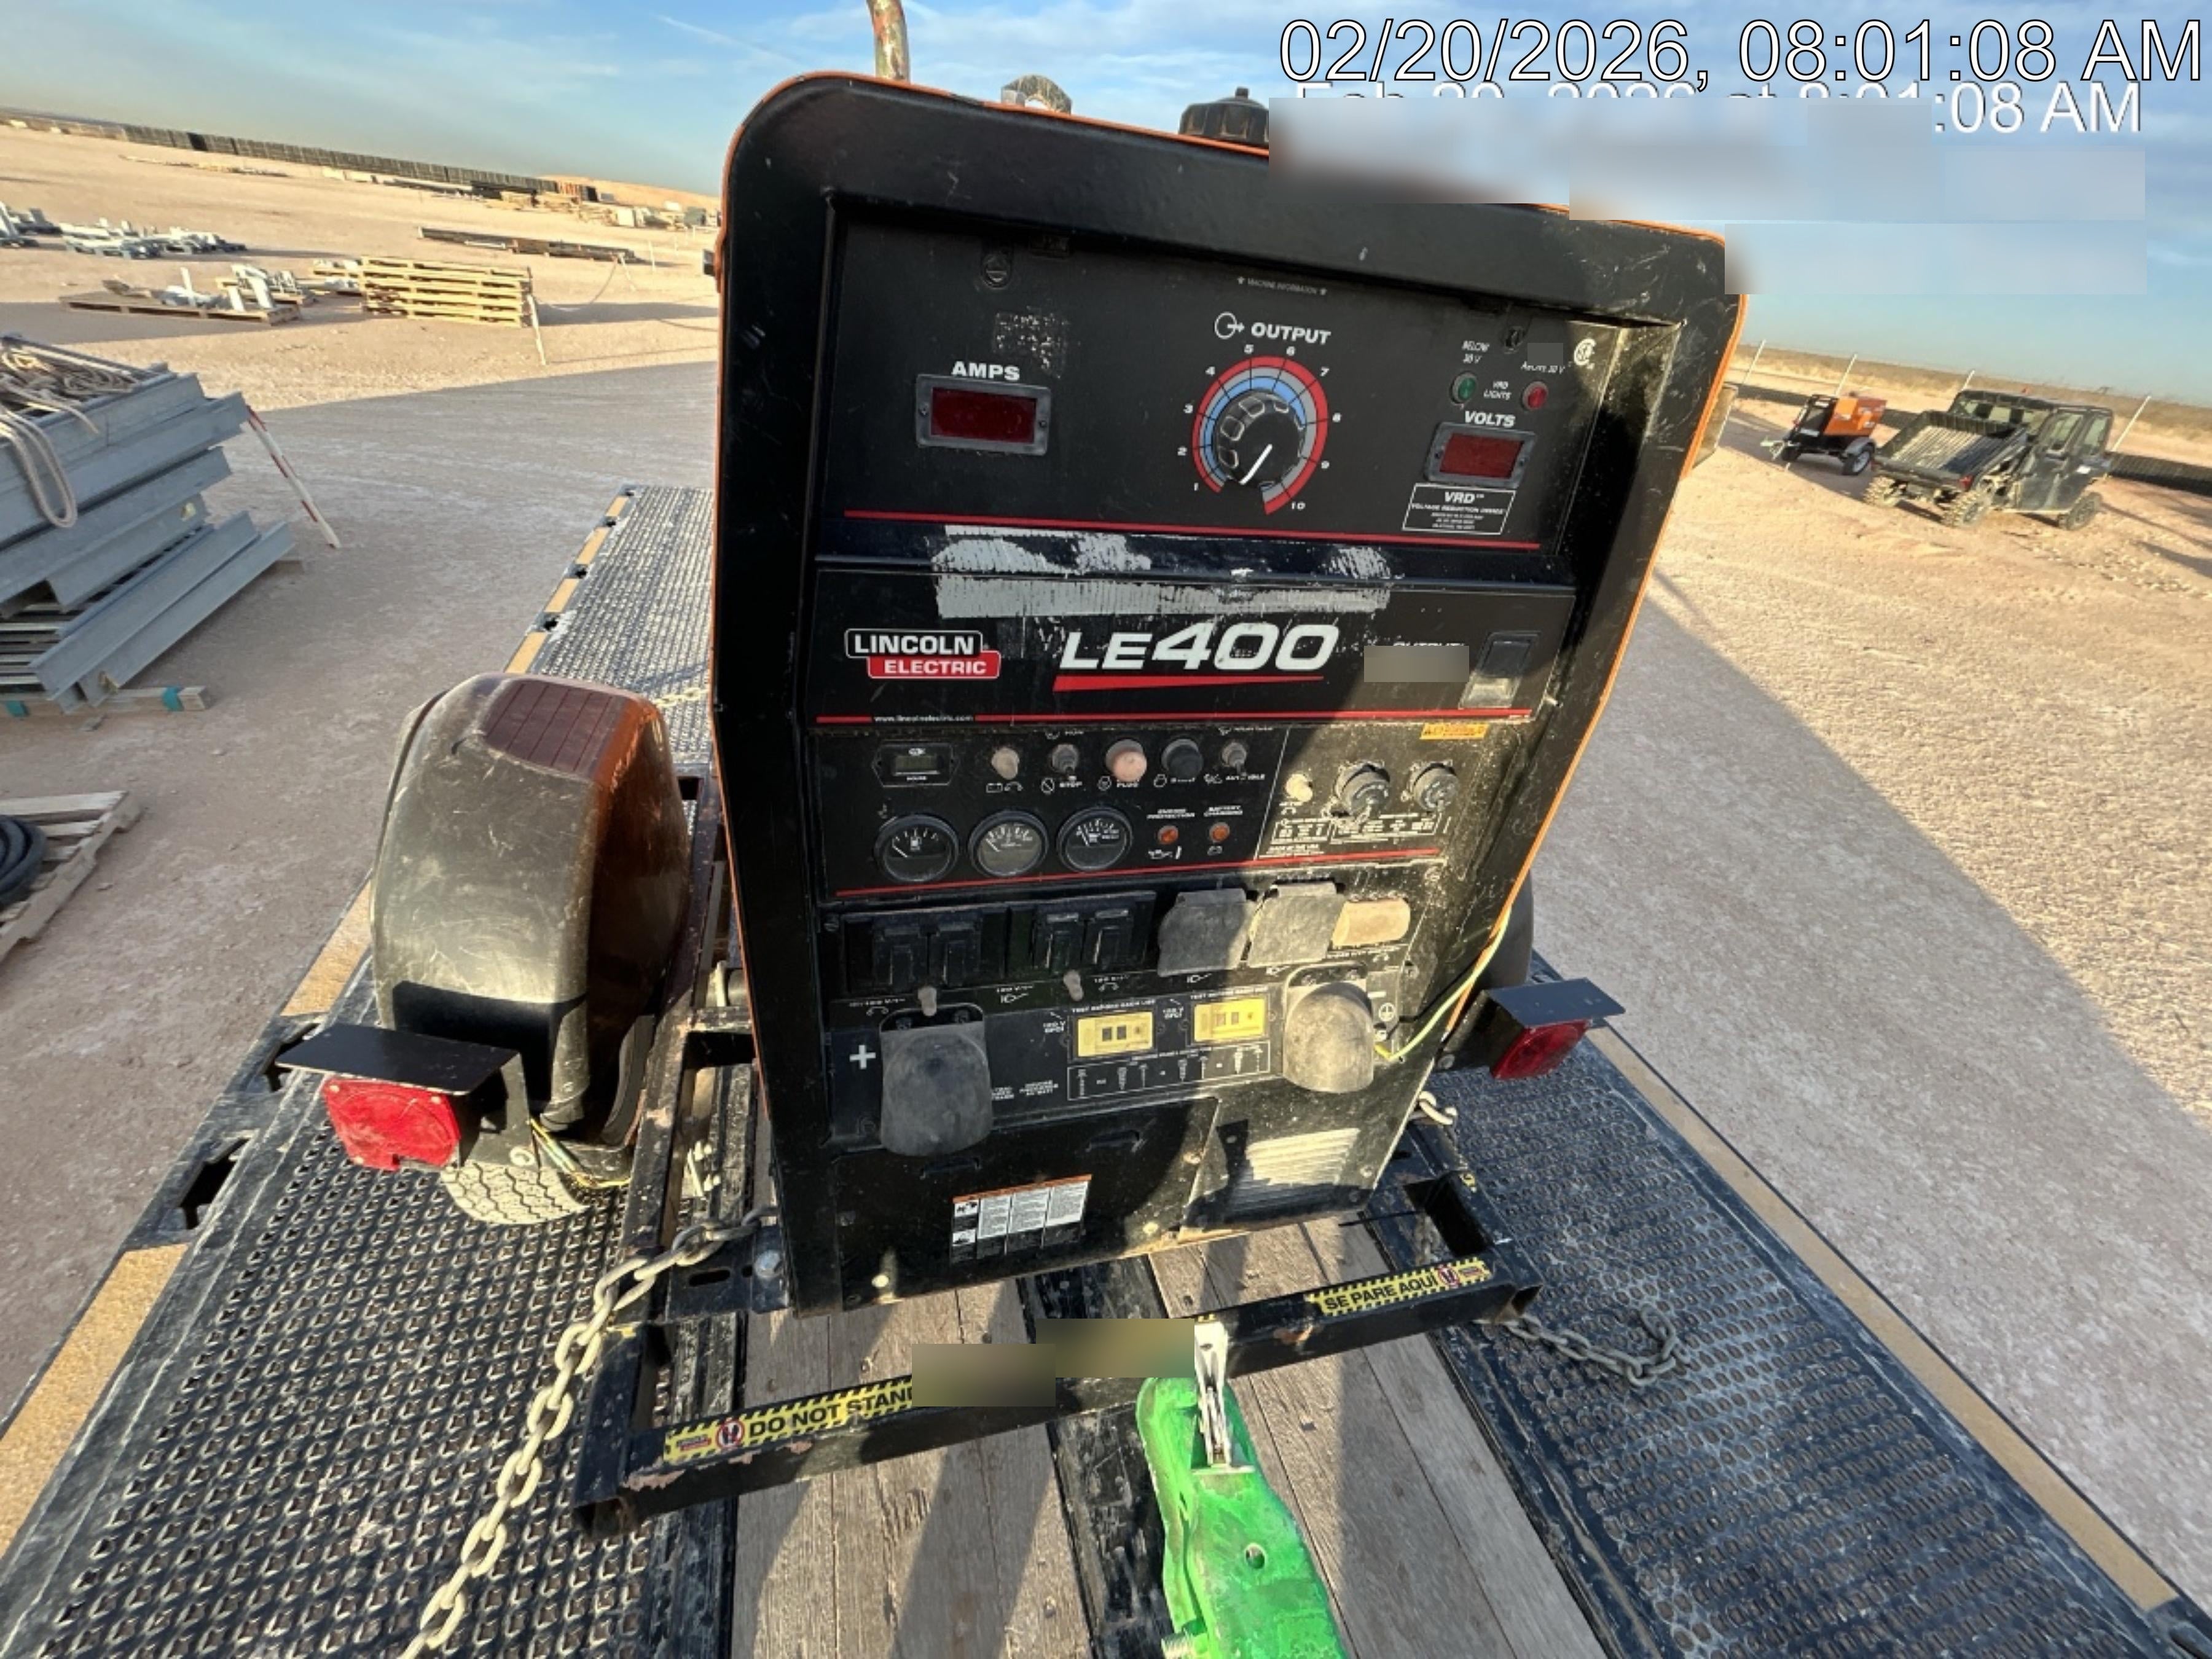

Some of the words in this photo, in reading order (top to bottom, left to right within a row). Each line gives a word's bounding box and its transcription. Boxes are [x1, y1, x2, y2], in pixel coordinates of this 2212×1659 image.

[1250, 321, 1332, 345] OUTPUT
[1244, 344, 1254, 354] 5
[1286, 346, 1296, 356] 6
[952, 360, 1021, 382] AMPS
[1205, 366, 1216, 377] 4
[1320, 367, 1330, 377] 7
[1183, 403, 1193, 414] 3
[1332, 412, 1342, 423] 8
[1464, 410, 1516, 427] VOLTS
[1177, 446, 1188, 456] 2
[1194, 482, 1199, 491] 1
[1291, 501, 1306, 510] 10
[854, 634, 975, 656] LINCOLN
[1059, 622, 1339, 670] LE400
[884, 659, 987, 675] ELECTRIC
[1324, 1295, 1349, 1310] SE
[1351, 1284, 1398, 1304] PARE
[749, 1418, 786, 1438] DO
[791, 1405, 840, 1427] NOT
